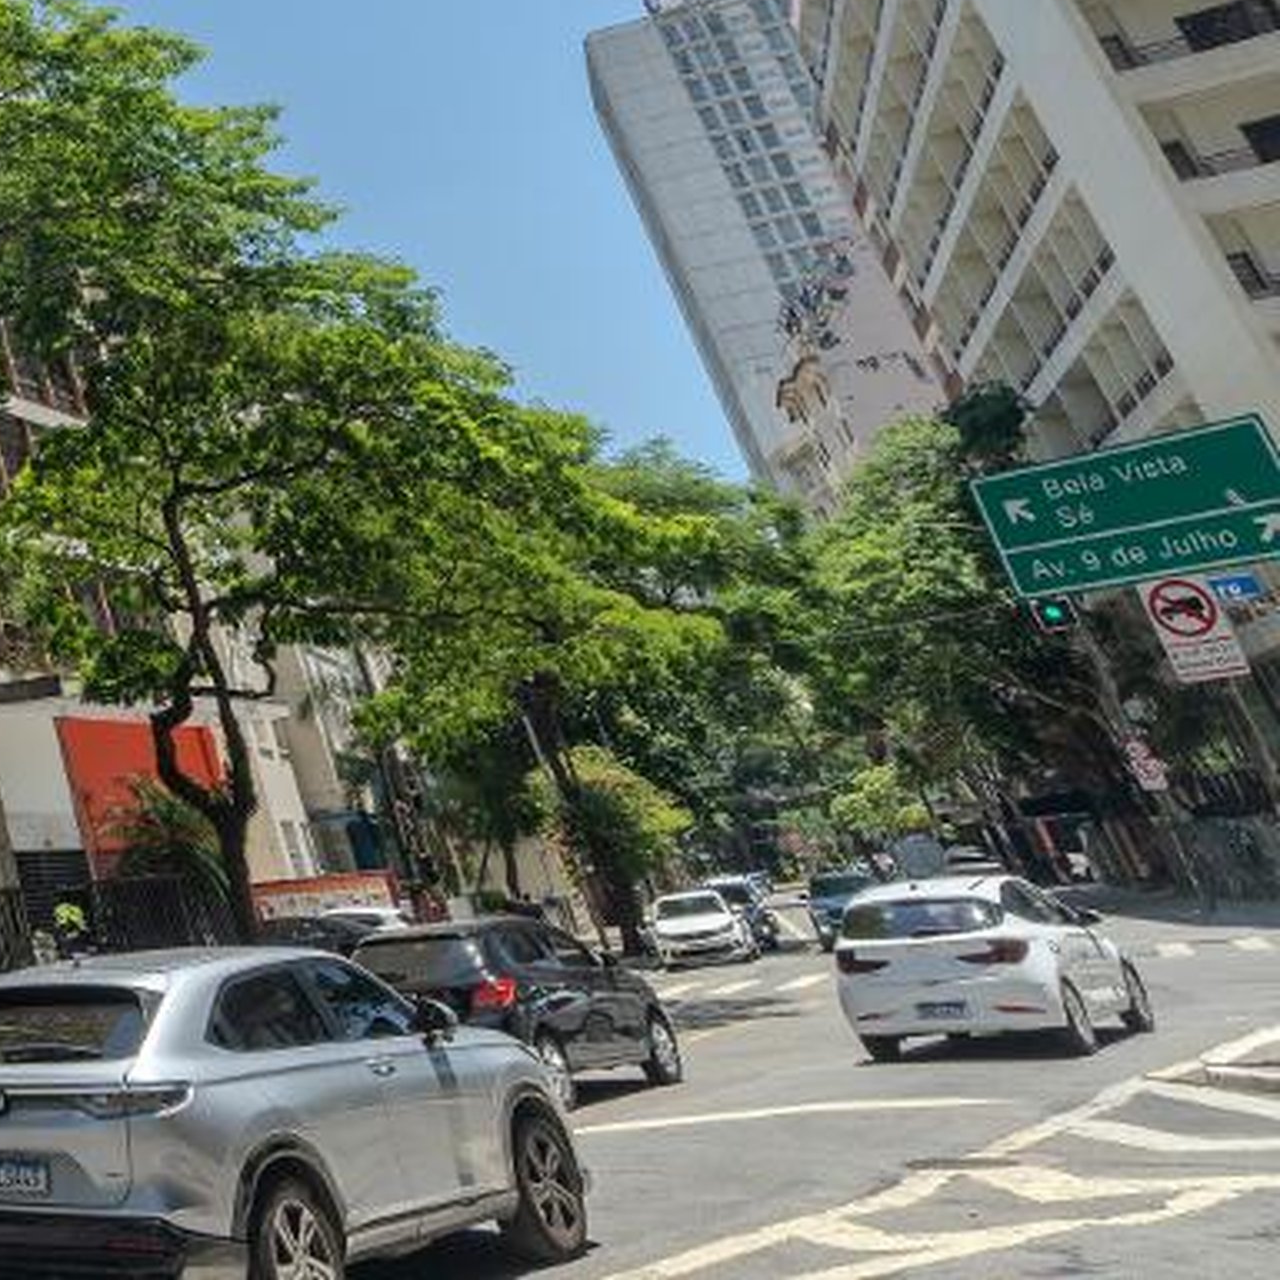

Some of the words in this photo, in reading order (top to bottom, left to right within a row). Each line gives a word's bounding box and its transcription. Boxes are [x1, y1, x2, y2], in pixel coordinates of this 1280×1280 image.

[1042, 472, 1105, 499] Bela
[1113, 454, 1188, 483] Vista
[1055, 502, 1094, 528] Sé
[1081, 550, 1101, 571] 9
[1112, 546, 1148, 568] de
[1158, 528, 1238, 560] Julho
